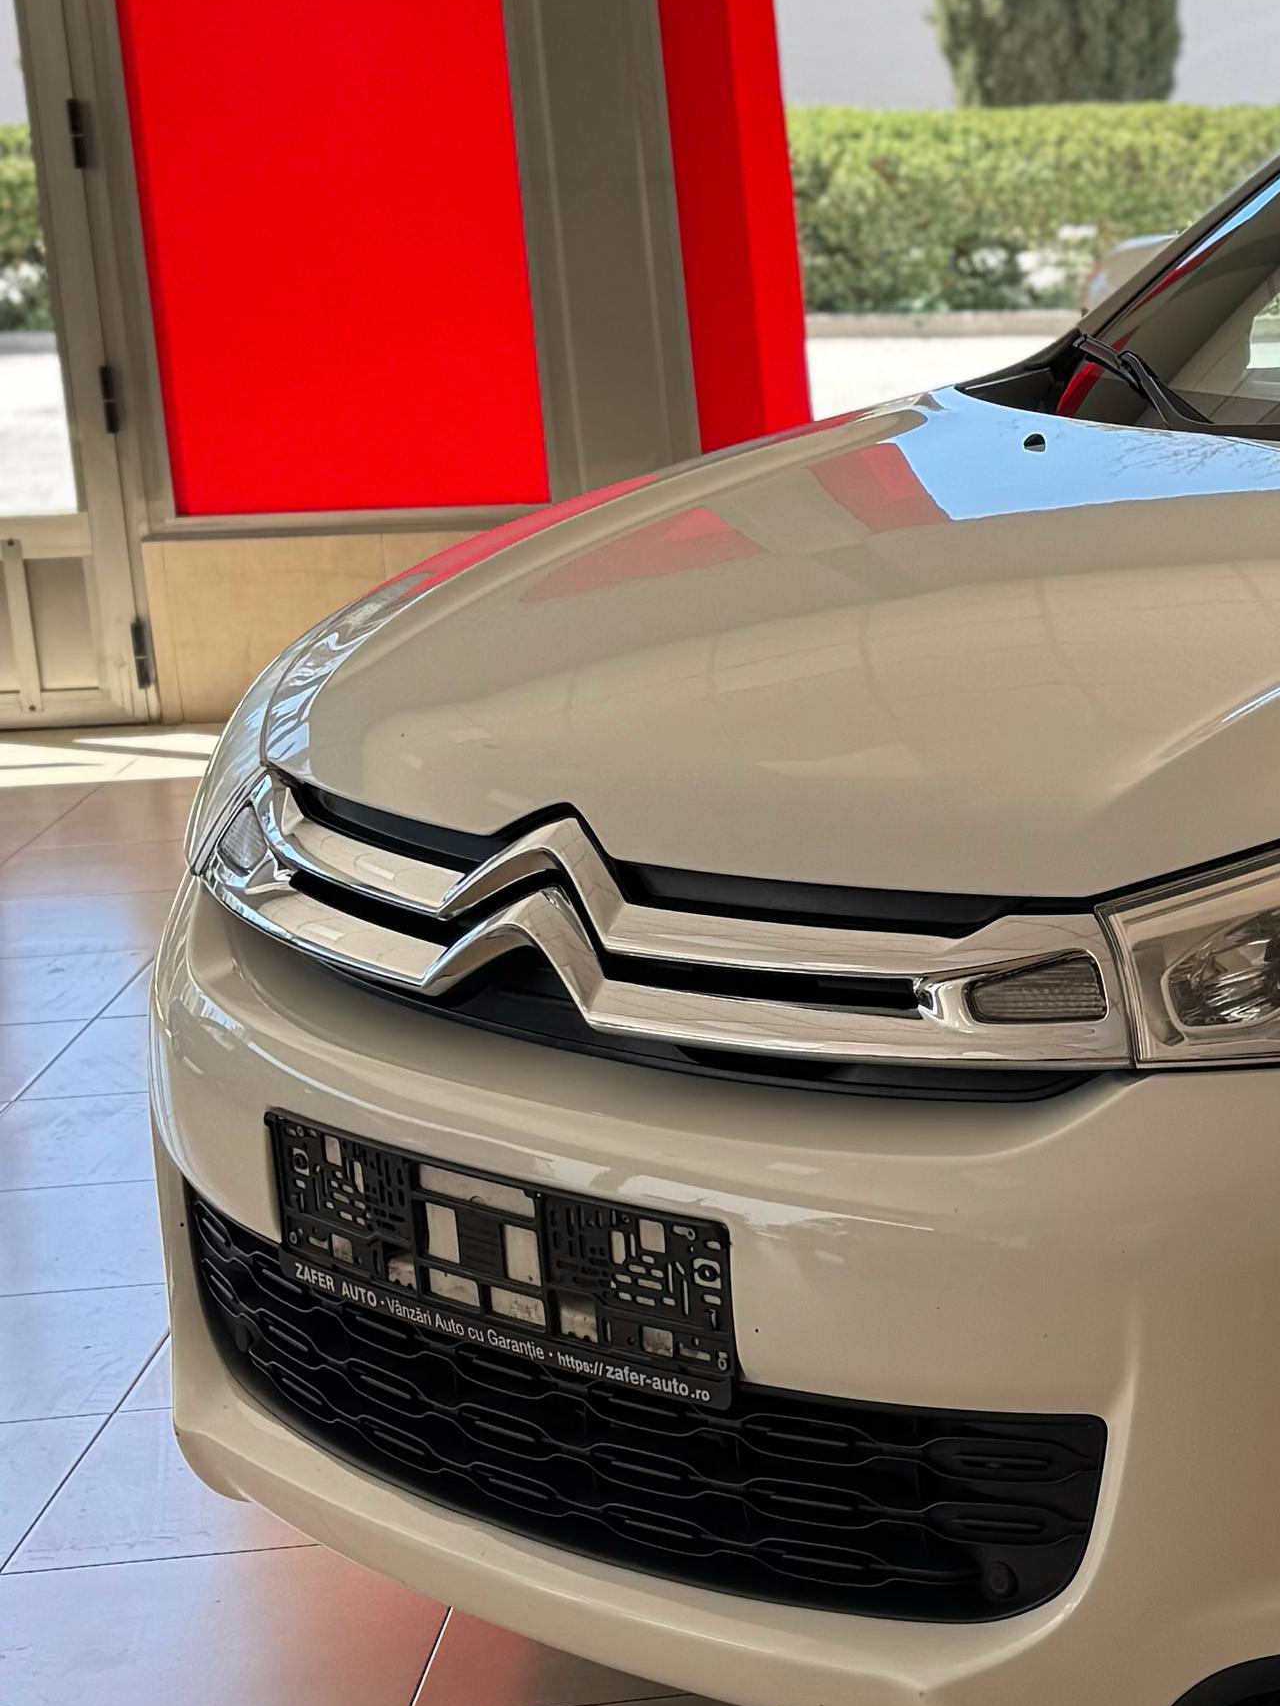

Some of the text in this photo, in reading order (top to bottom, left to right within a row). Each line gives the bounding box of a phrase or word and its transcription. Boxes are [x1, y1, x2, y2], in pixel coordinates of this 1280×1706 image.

[294, 1261, 336, 1294] ZAFER
[341, 1280, 378, 1309] AUTO
[385, 1295, 432, 1327] Vânzări
[434, 1312, 465, 1338] Auto
[467, 1325, 485, 1343] cu
